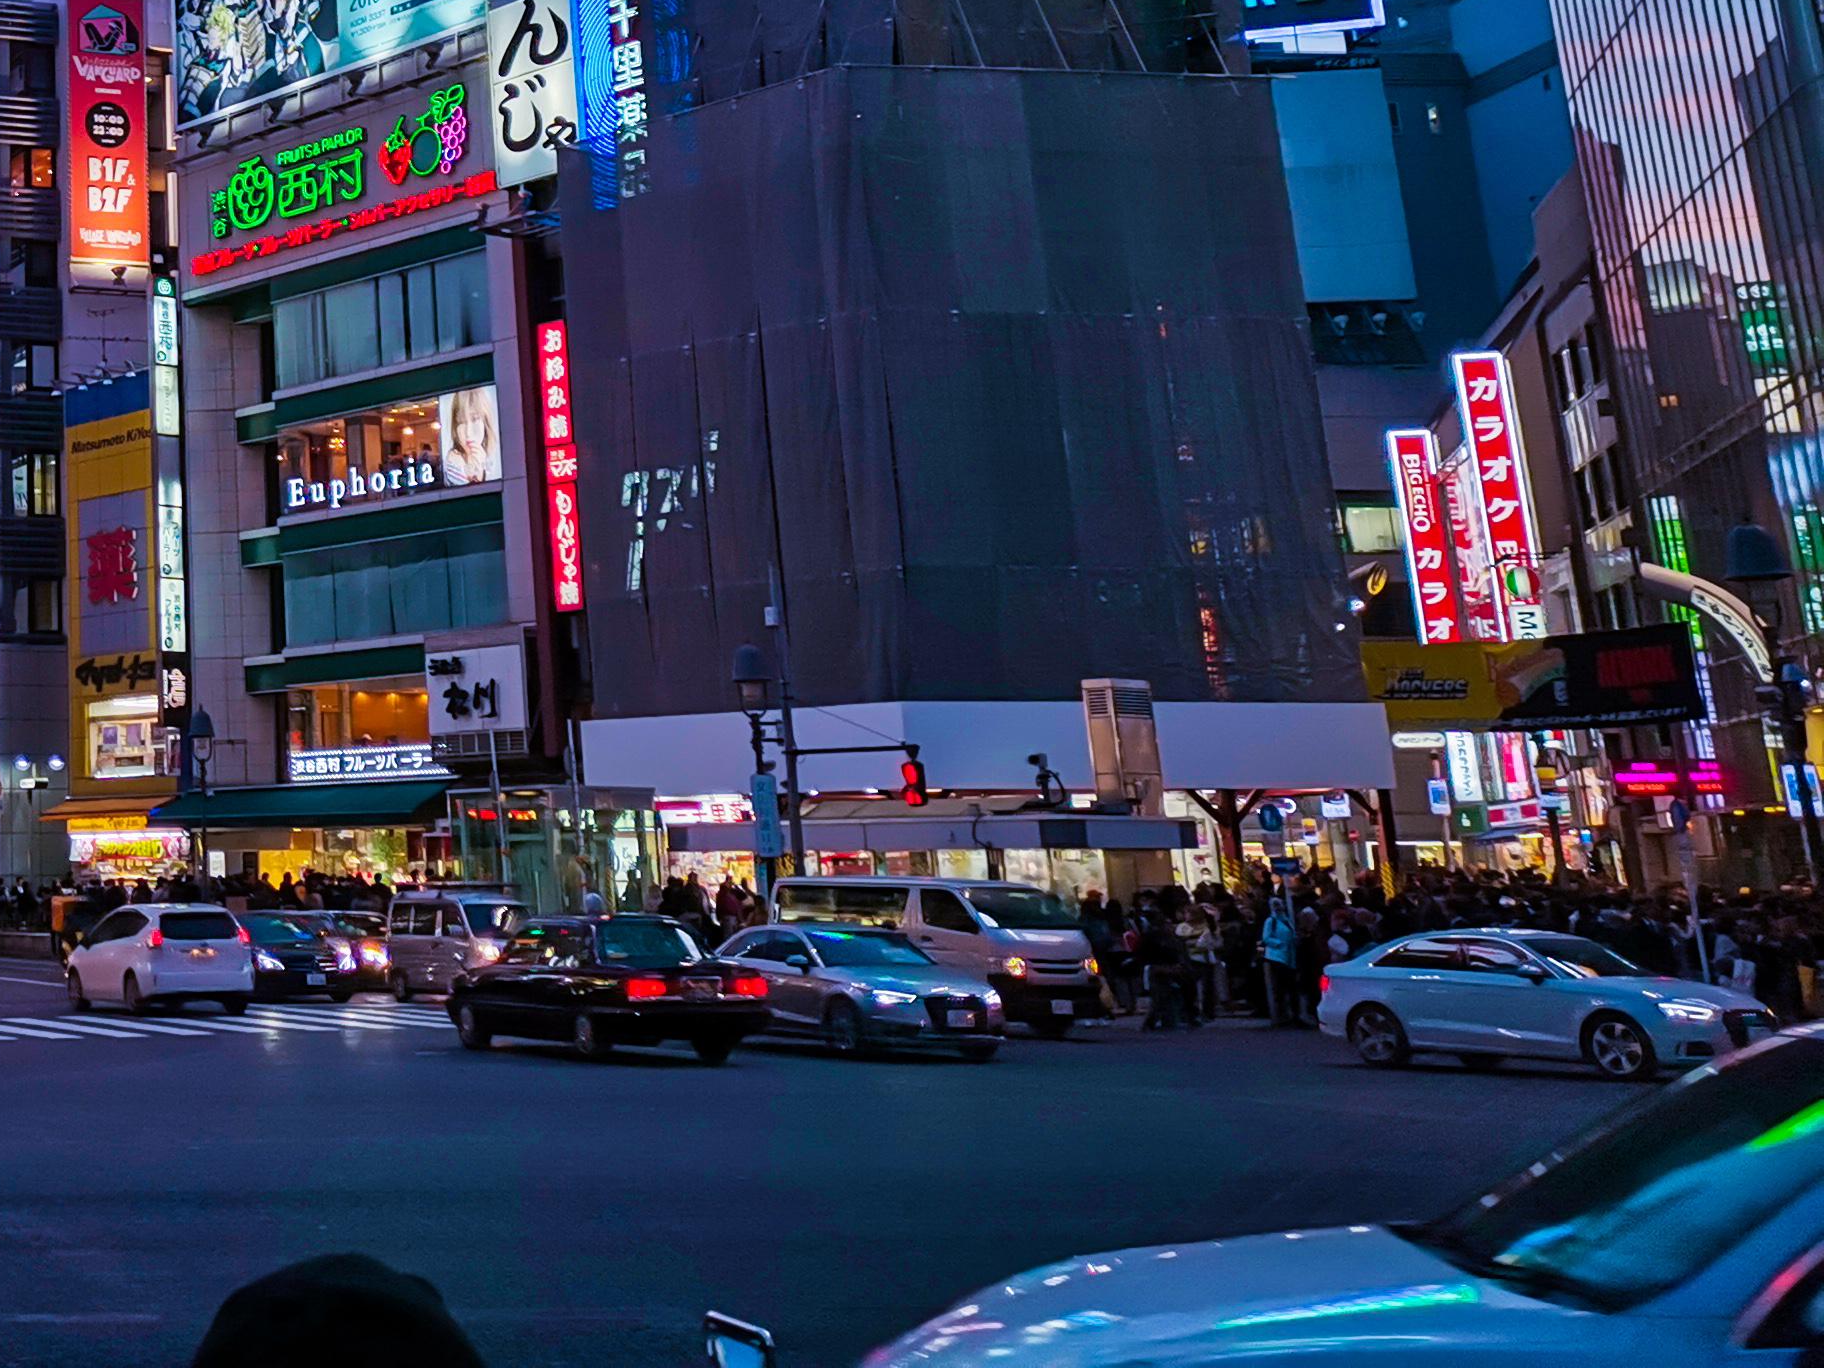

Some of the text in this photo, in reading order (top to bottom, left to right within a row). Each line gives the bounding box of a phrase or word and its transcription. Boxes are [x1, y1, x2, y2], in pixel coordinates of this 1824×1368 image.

[88, 157, 131, 182] B1F
[88, 187, 133, 213] B2F
[277, 147, 364, 219] 西村
[71, 434, 125, 454] Matsumoto
[1468, 377, 1520, 523] カラオケ
[287, 457, 435, 508] Euphoria
[1401, 453, 1432, 533] BIG ECHO
[1416, 548, 1455, 641] カラオ
